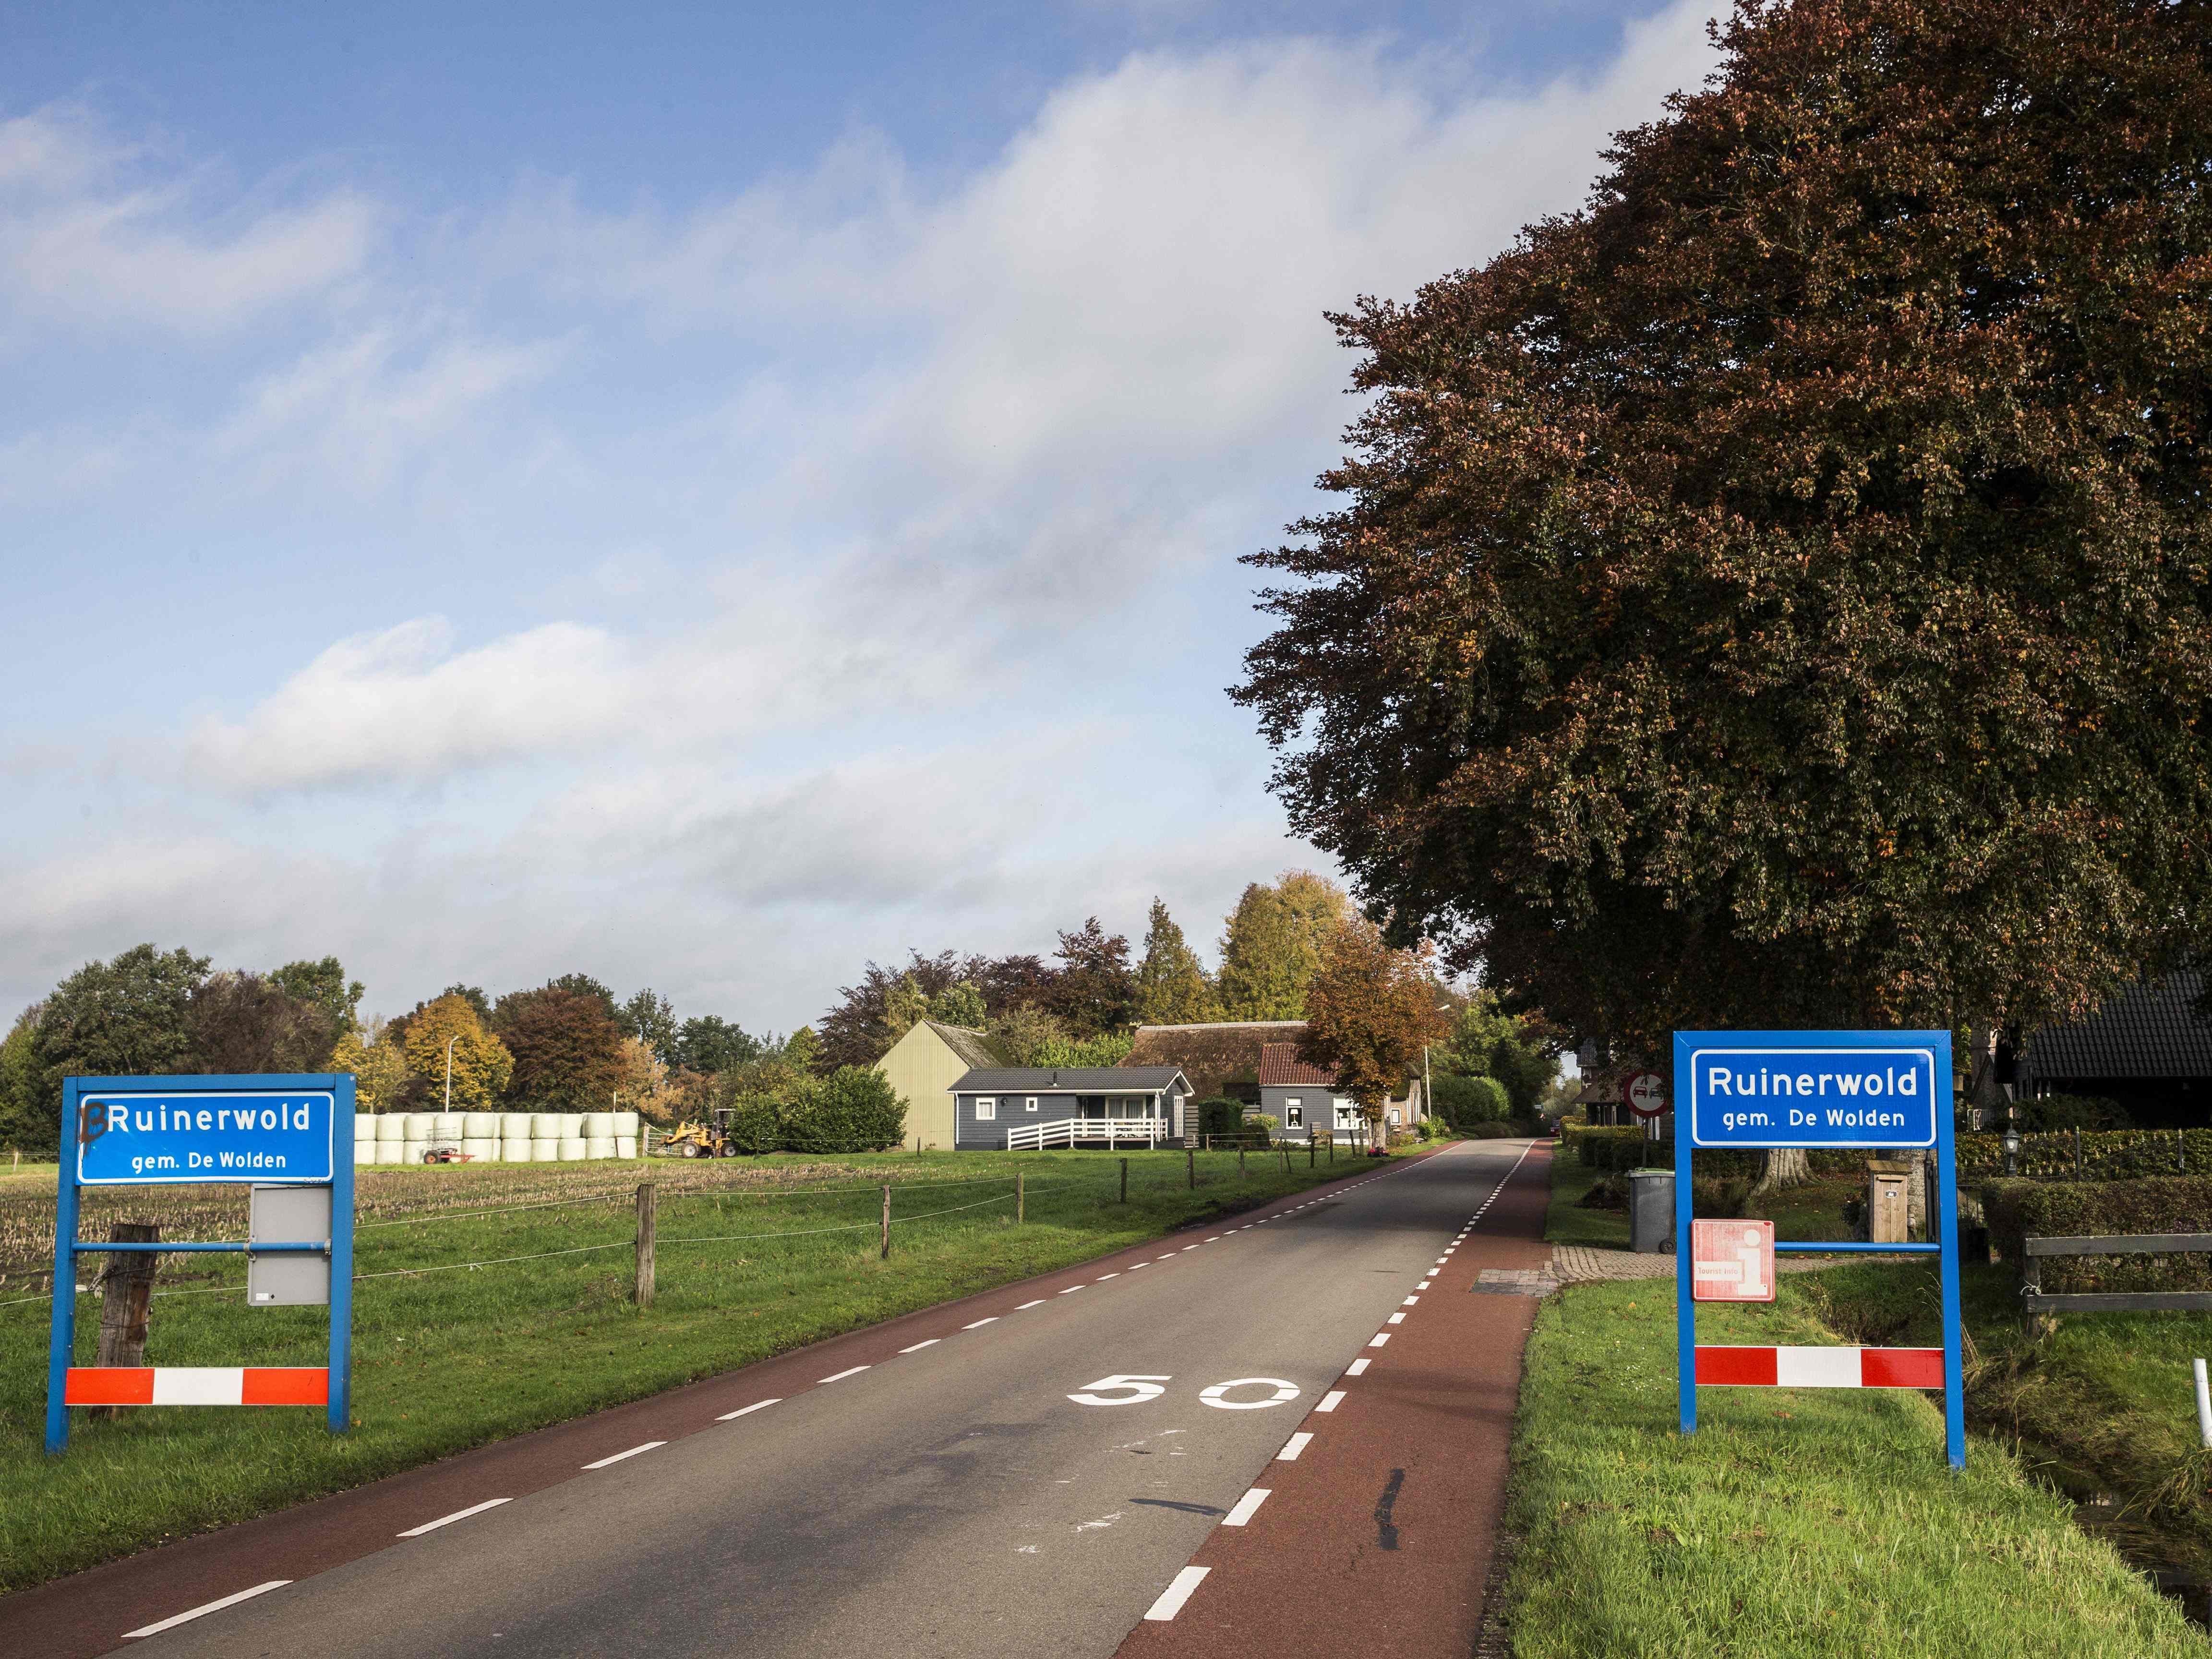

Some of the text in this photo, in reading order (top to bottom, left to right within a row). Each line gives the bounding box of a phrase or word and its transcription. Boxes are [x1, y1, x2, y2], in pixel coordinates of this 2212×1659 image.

[1709, 1067, 1917, 1096] Ruinerwold
[108, 1103, 310, 1132] Ruinerwold
[1722, 1109, 1905, 1131] gem. De Wolden
[132, 1152, 286, 1174] gem. De Wolden
[1698, 1267, 1721, 1275] Tourist
[1066, 1374, 1300, 1409] 50
